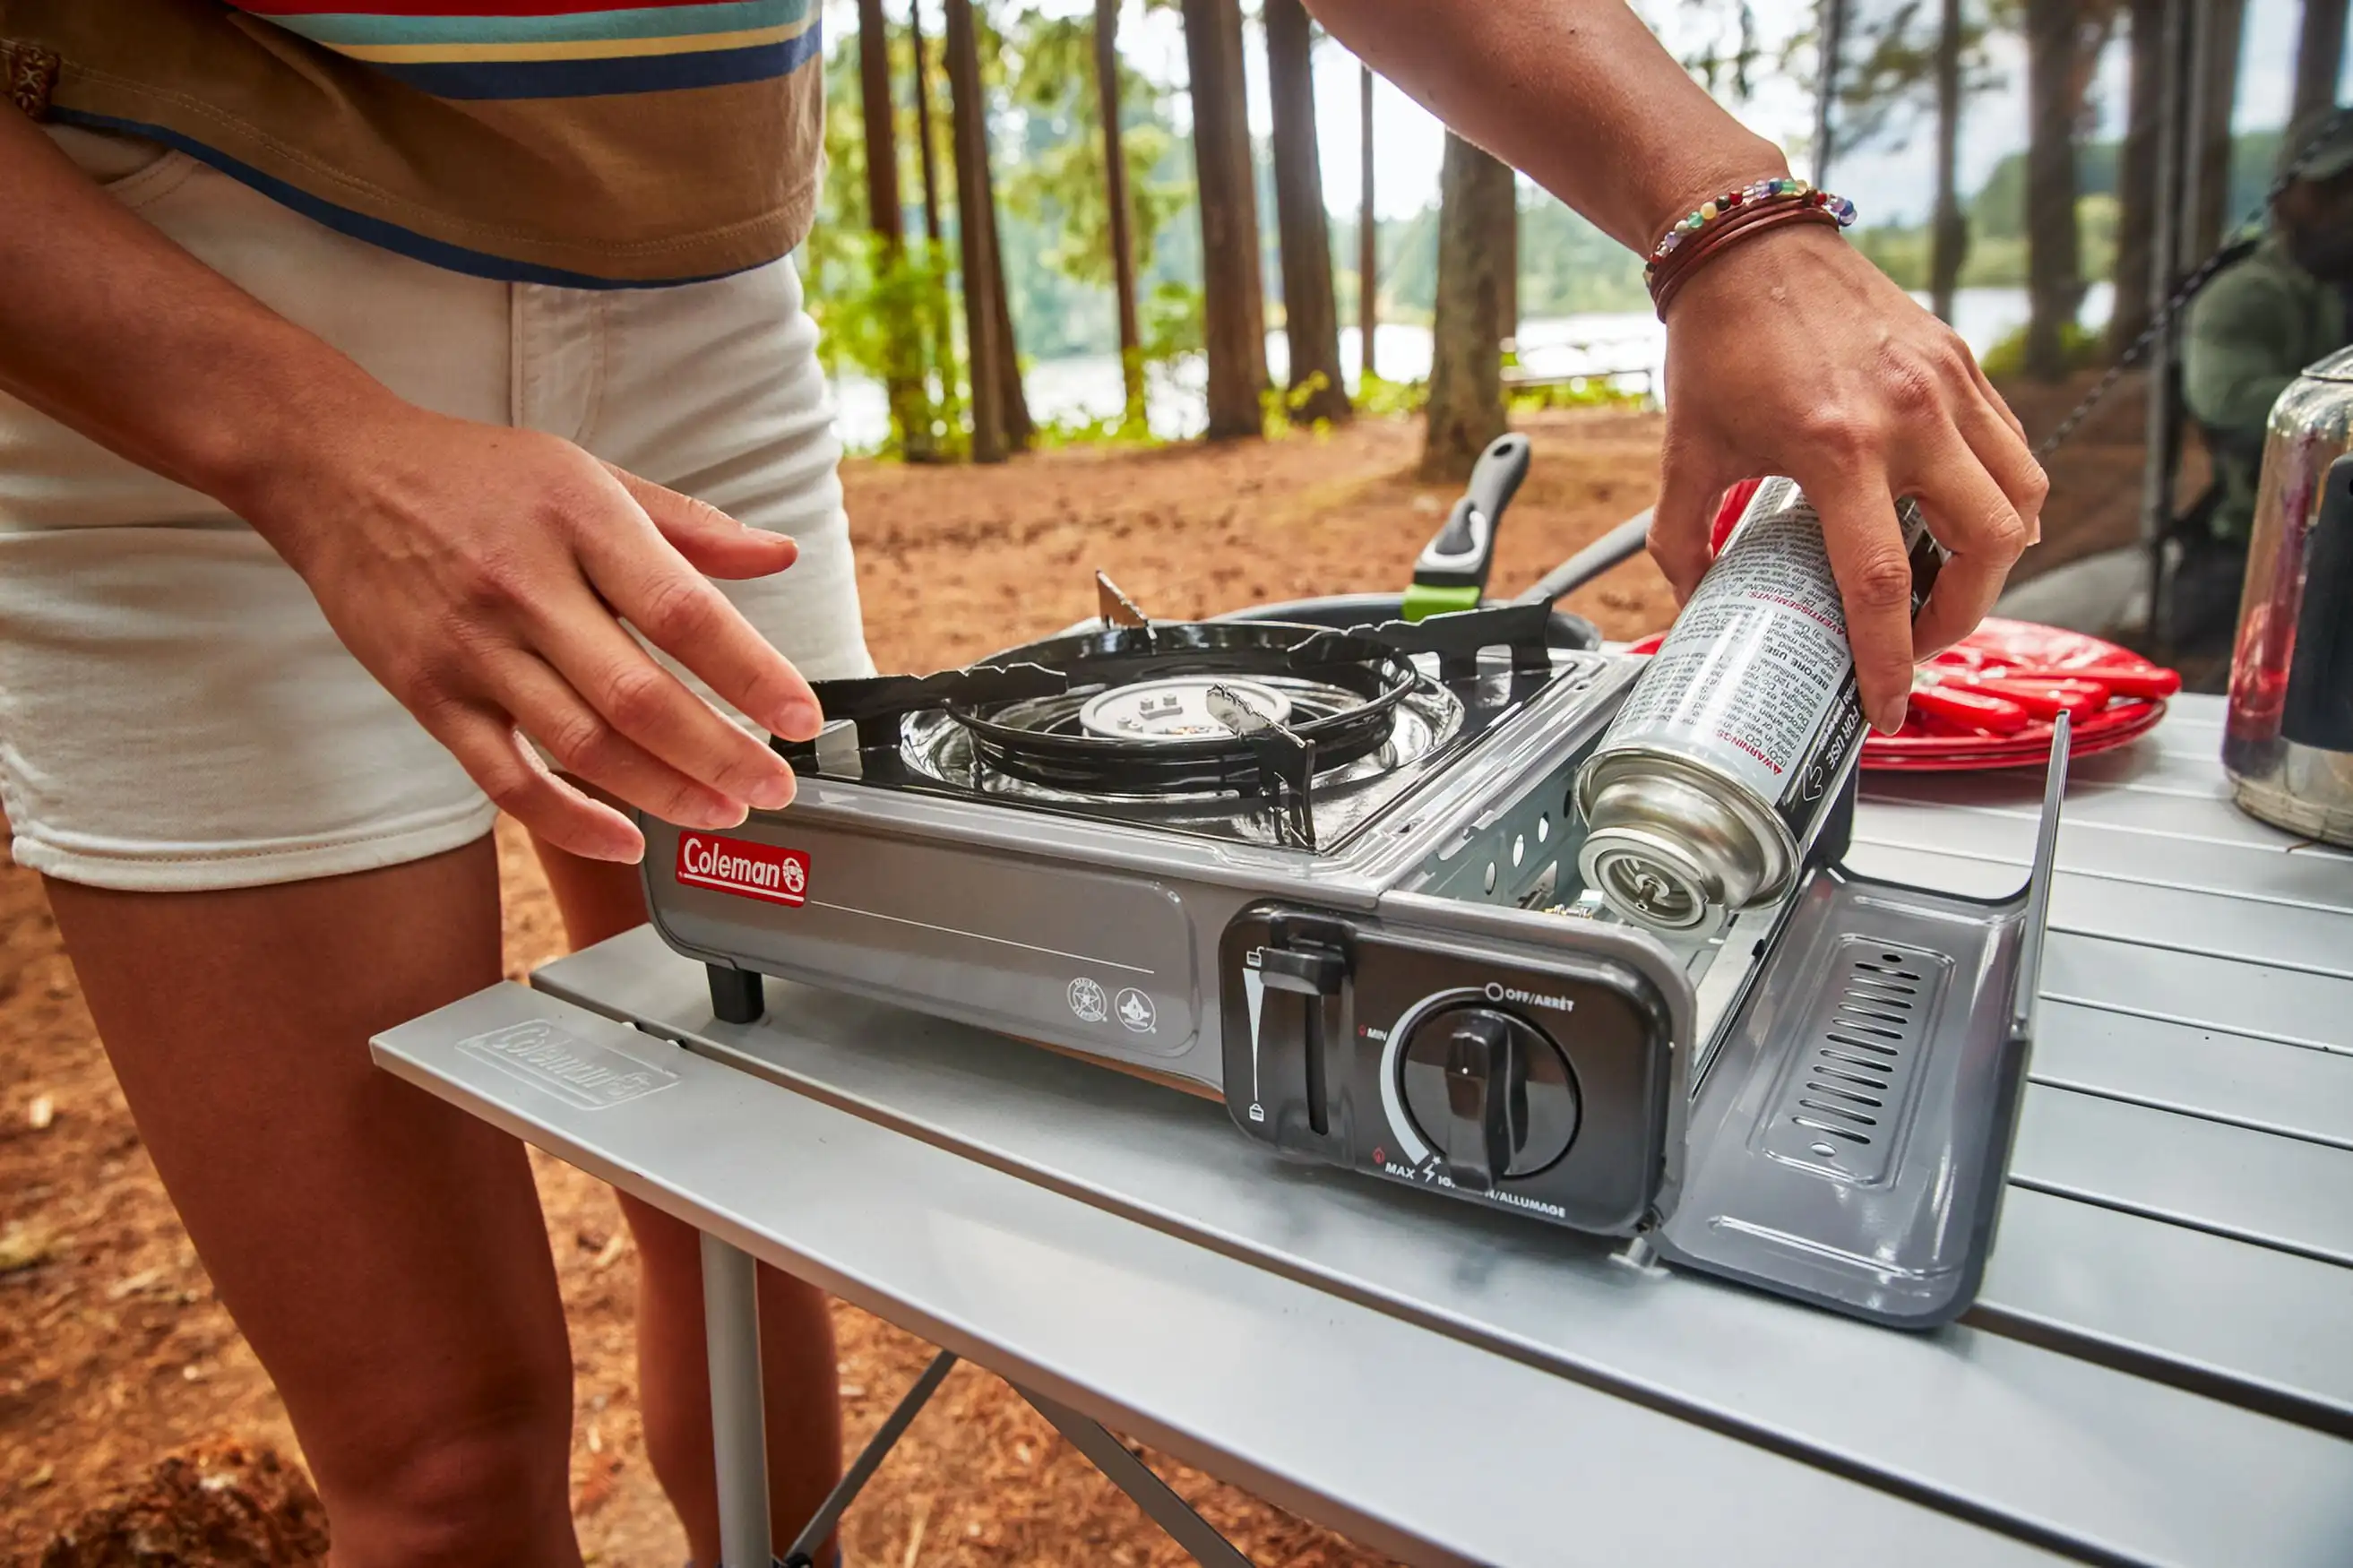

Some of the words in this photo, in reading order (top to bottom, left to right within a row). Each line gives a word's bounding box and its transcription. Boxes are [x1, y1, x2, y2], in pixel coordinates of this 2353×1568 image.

[1843, 704, 1862, 739] FOR
[1825, 736, 1846, 770] USE
[683, 837, 780, 888] Coleman
[1505, 987, 1574, 1012] OFF/ARRÊT
[1385, 1161, 1416, 1181] MAX
